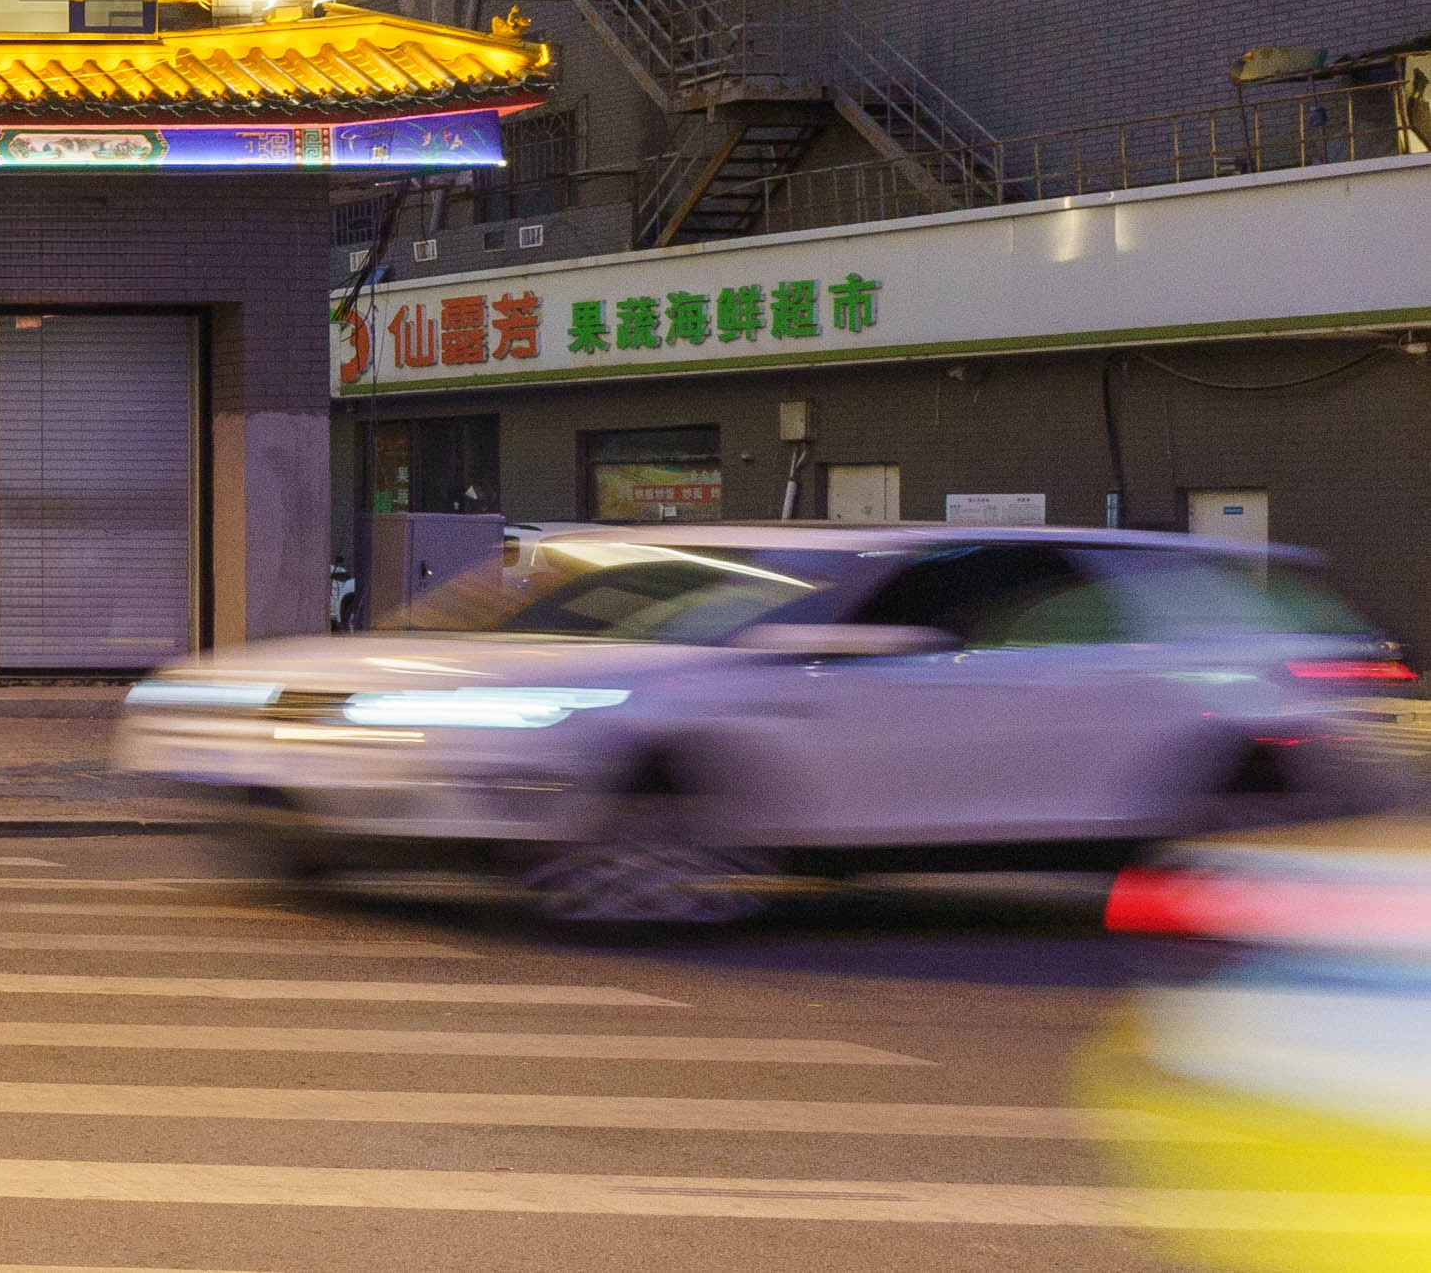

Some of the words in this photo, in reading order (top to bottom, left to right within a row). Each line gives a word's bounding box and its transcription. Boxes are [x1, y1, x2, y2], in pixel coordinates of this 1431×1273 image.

[567, 273, 882, 353] 果蔬海鲜超市
